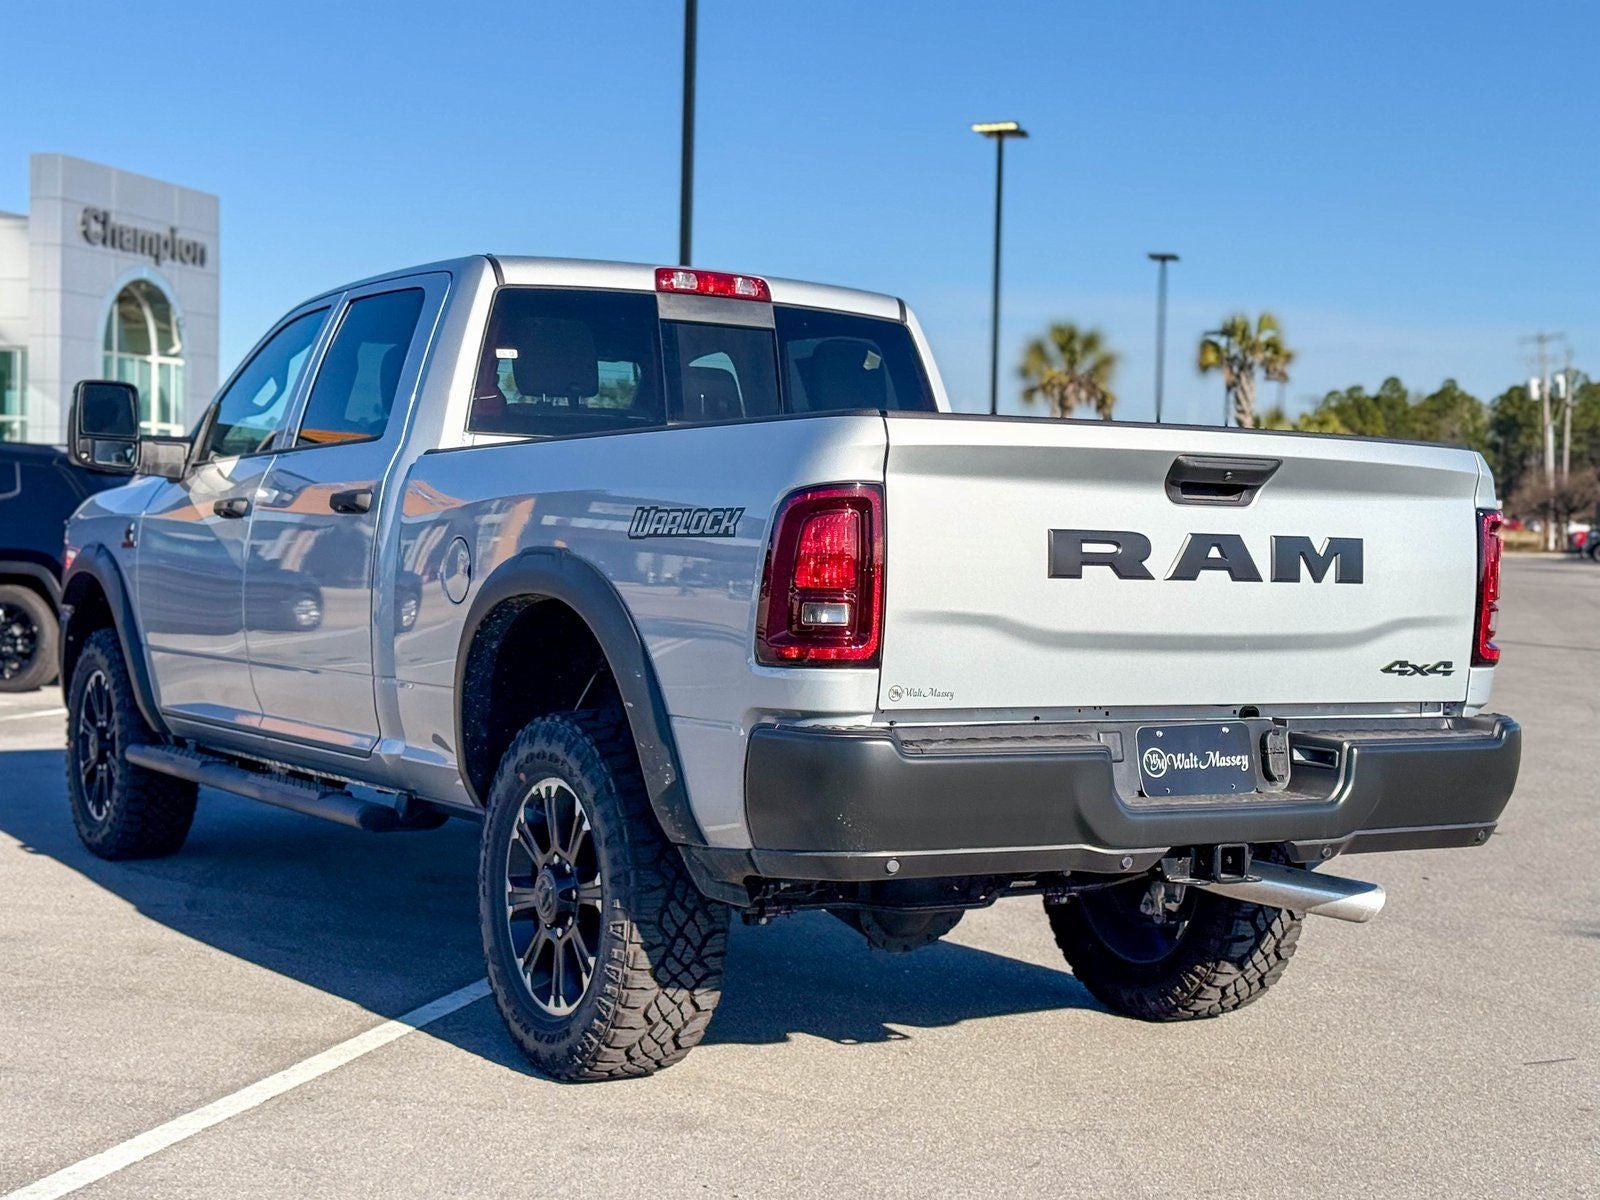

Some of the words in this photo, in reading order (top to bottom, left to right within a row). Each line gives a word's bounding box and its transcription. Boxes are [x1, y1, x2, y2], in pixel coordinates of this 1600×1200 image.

[80, 206, 207, 266] Champion
[628, 506, 746, 539] WARLOCK
[1047, 528, 1364, 584] RAM
[905, 687, 923, 698] Walt
[923, 687, 954, 701] Massey
[1167, 753, 1199, 770] Walt
[1199, 751, 1249, 771] Massey
